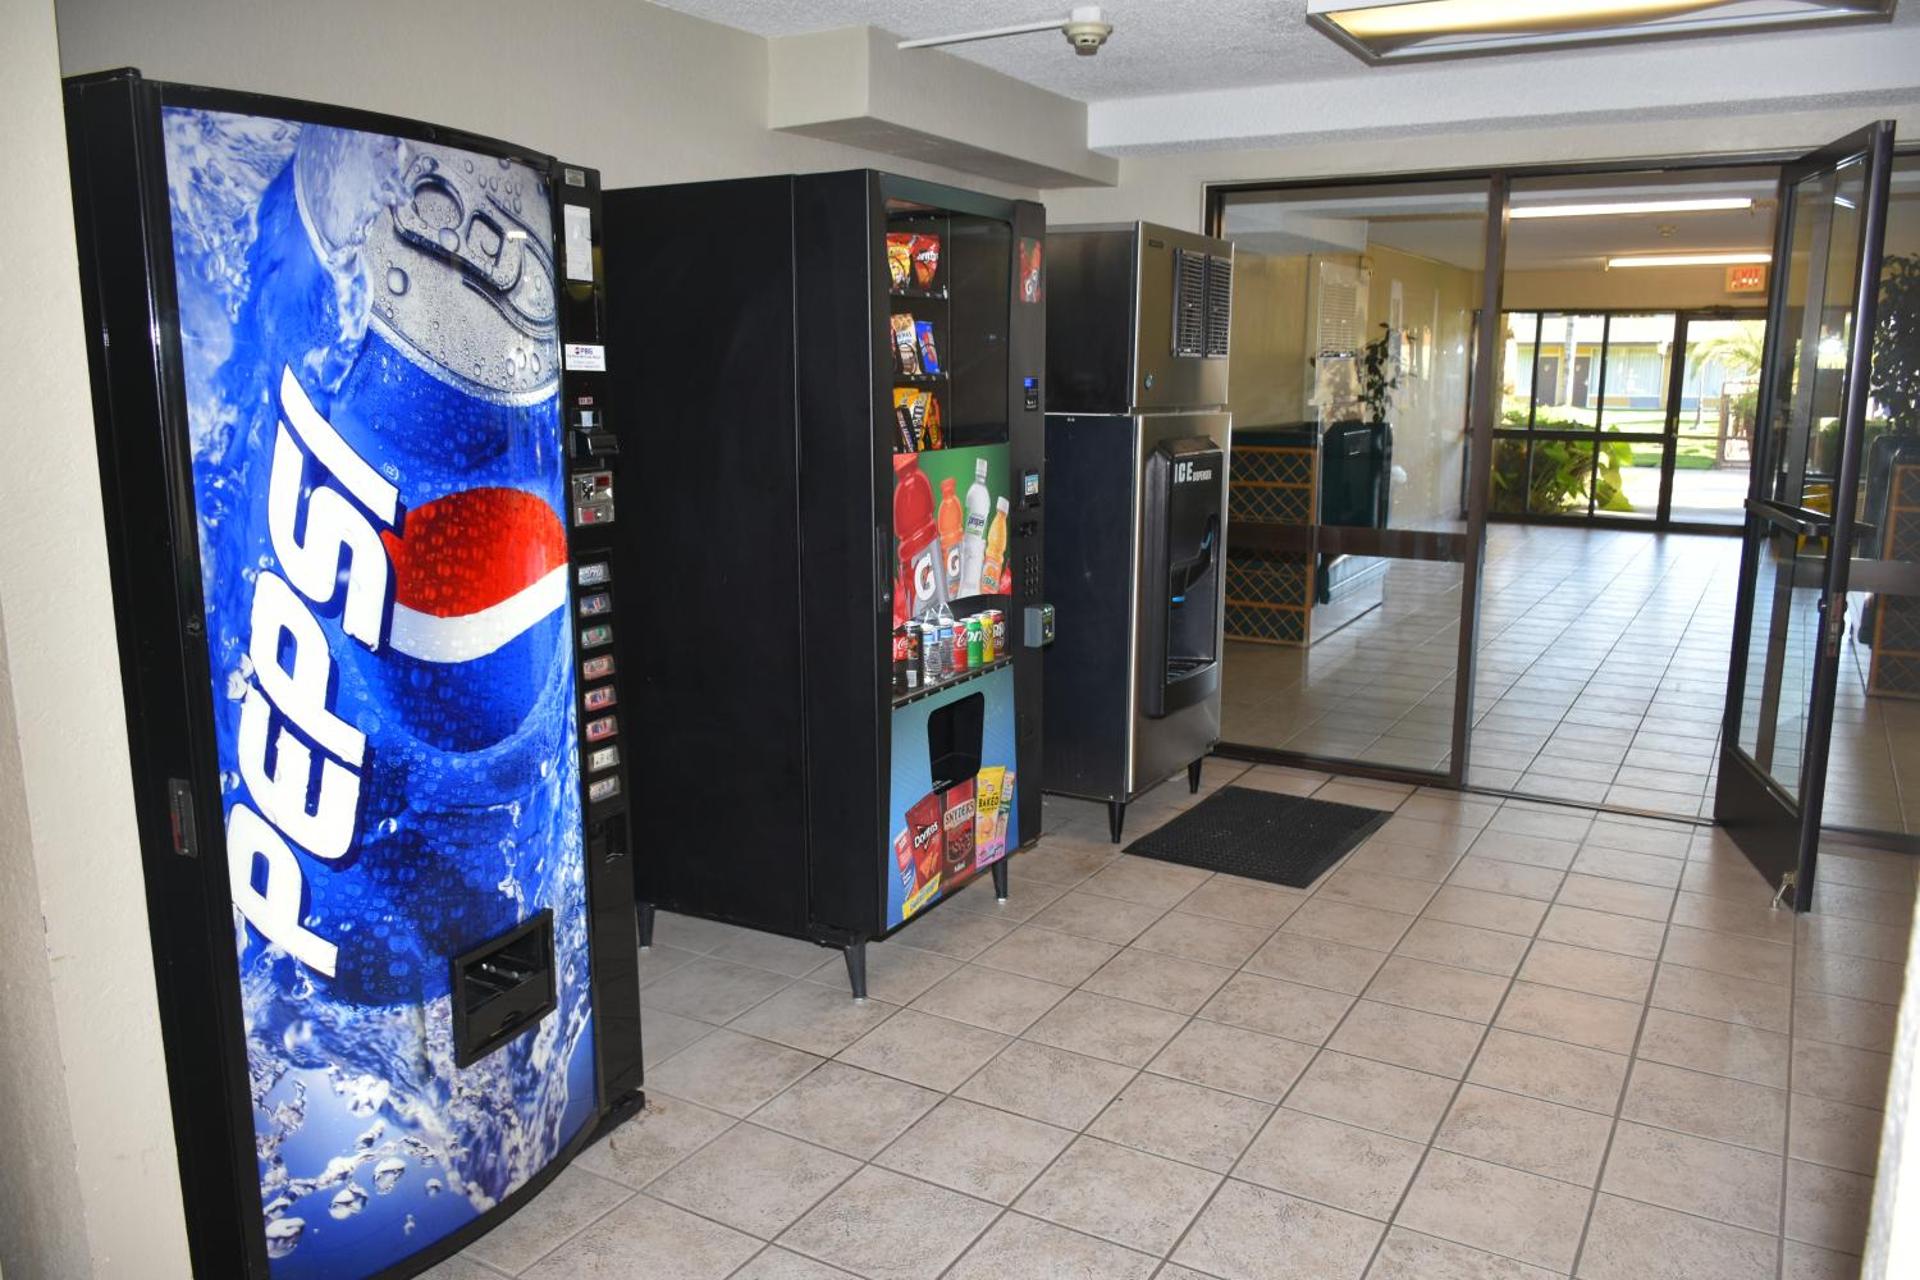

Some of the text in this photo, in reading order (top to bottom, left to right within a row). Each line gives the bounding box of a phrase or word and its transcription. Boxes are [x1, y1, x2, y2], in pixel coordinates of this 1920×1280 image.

[1174, 461, 1193, 483] ICE
[914, 553, 936, 600] G
[947, 547, 960, 577] G
[227, 362, 400, 979] PEPSI
